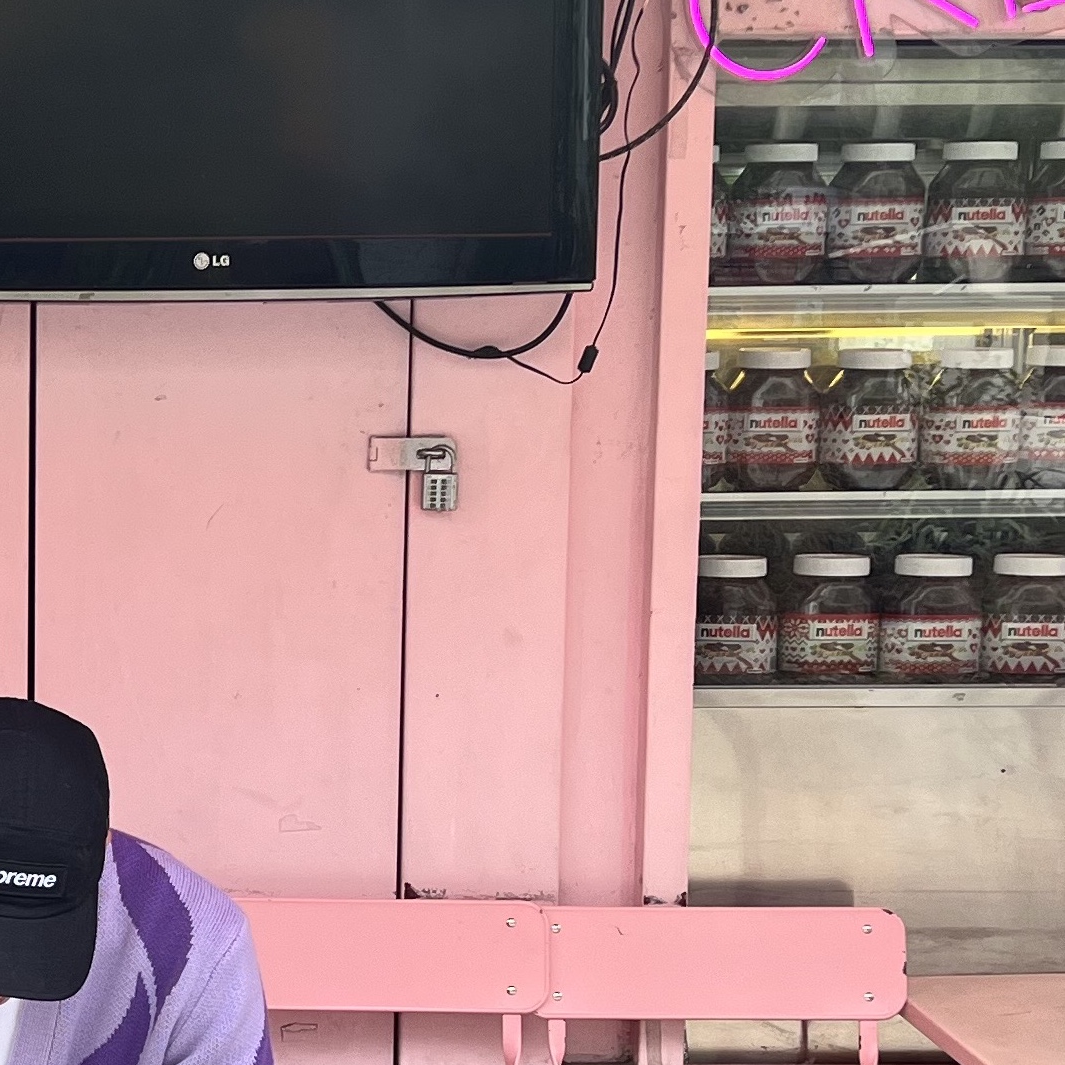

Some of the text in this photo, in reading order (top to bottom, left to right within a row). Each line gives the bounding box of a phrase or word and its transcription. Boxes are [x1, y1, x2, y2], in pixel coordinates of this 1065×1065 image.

[761, 208, 810, 222] nutella
[857, 208, 905, 222] nutella
[958, 208, 1006, 221] nutella
[212, 255, 230, 267] LG
[749, 416, 798, 429] nutella
[858, 415, 905, 429] nutella
[962, 415, 1007, 429] nutella
[700, 625, 751, 639] nutella
[815, 624, 864, 638] nutella
[913, 625, 963, 638] nutella
[1007, 625, 1059, 638] nutella
